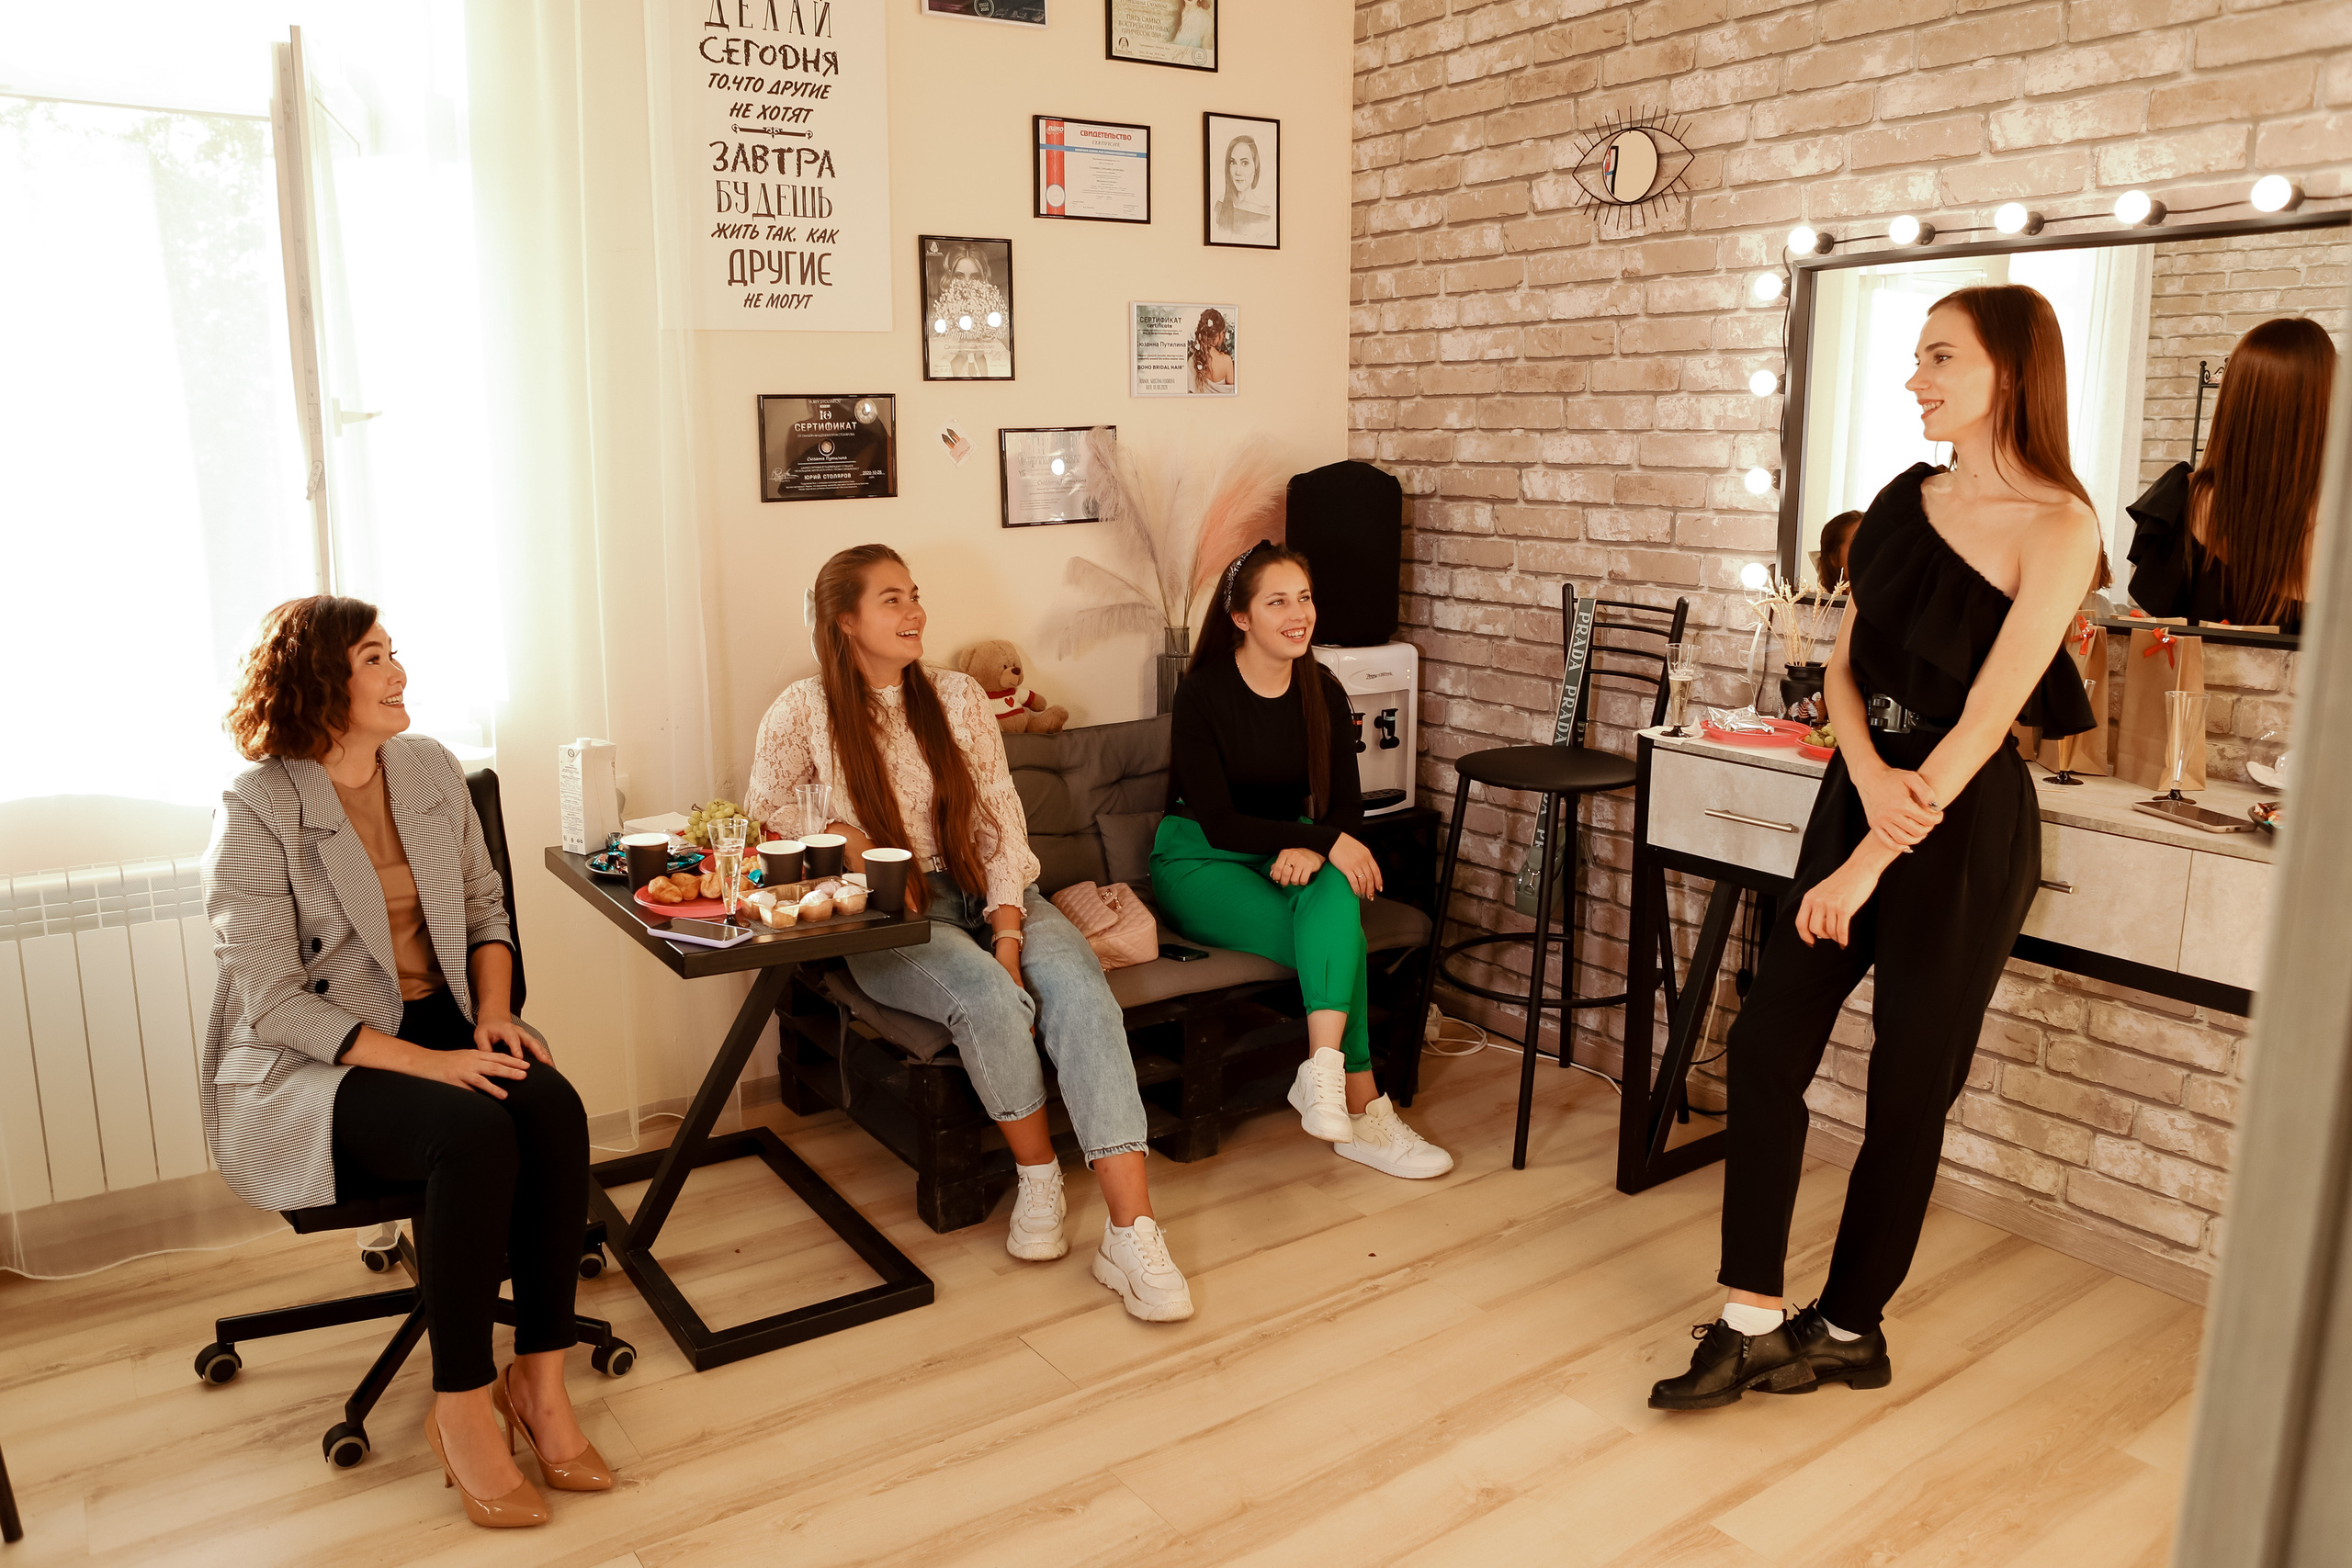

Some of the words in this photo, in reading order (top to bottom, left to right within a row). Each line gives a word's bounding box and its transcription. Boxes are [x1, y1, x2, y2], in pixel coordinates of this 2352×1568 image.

[705, 0, 832, 38] ДЕЛАЙ
[1142, 16, 1161, 24] САМЫХ
[699, 35, 839, 77] СЕГОДНЯ
[767, 79, 831, 100] ДРУГИЕ
[729, 102, 753, 118] НЕ
[757, 105, 814, 124] ХОТЯТ
[1080, 130, 1132, 141] СВИДЕТЕЛЬСТВО
[709, 141, 836, 179] ЗАВТРА
[715, 179, 833, 221] БУДЕШЬ
[711, 222, 760, 241] ЖИТЬ
[806, 228, 840, 244] КАК
[728, 248, 833, 287] ДРУГИЕ
[743, 292, 763, 308] НЕ
[765, 293, 813, 310] МОГУТ
[795, 422, 857, 432] СЕРТИФИКАТ
[1567, 611, 1591, 671] PRADA
[1554, 684, 1578, 744] PRADA
